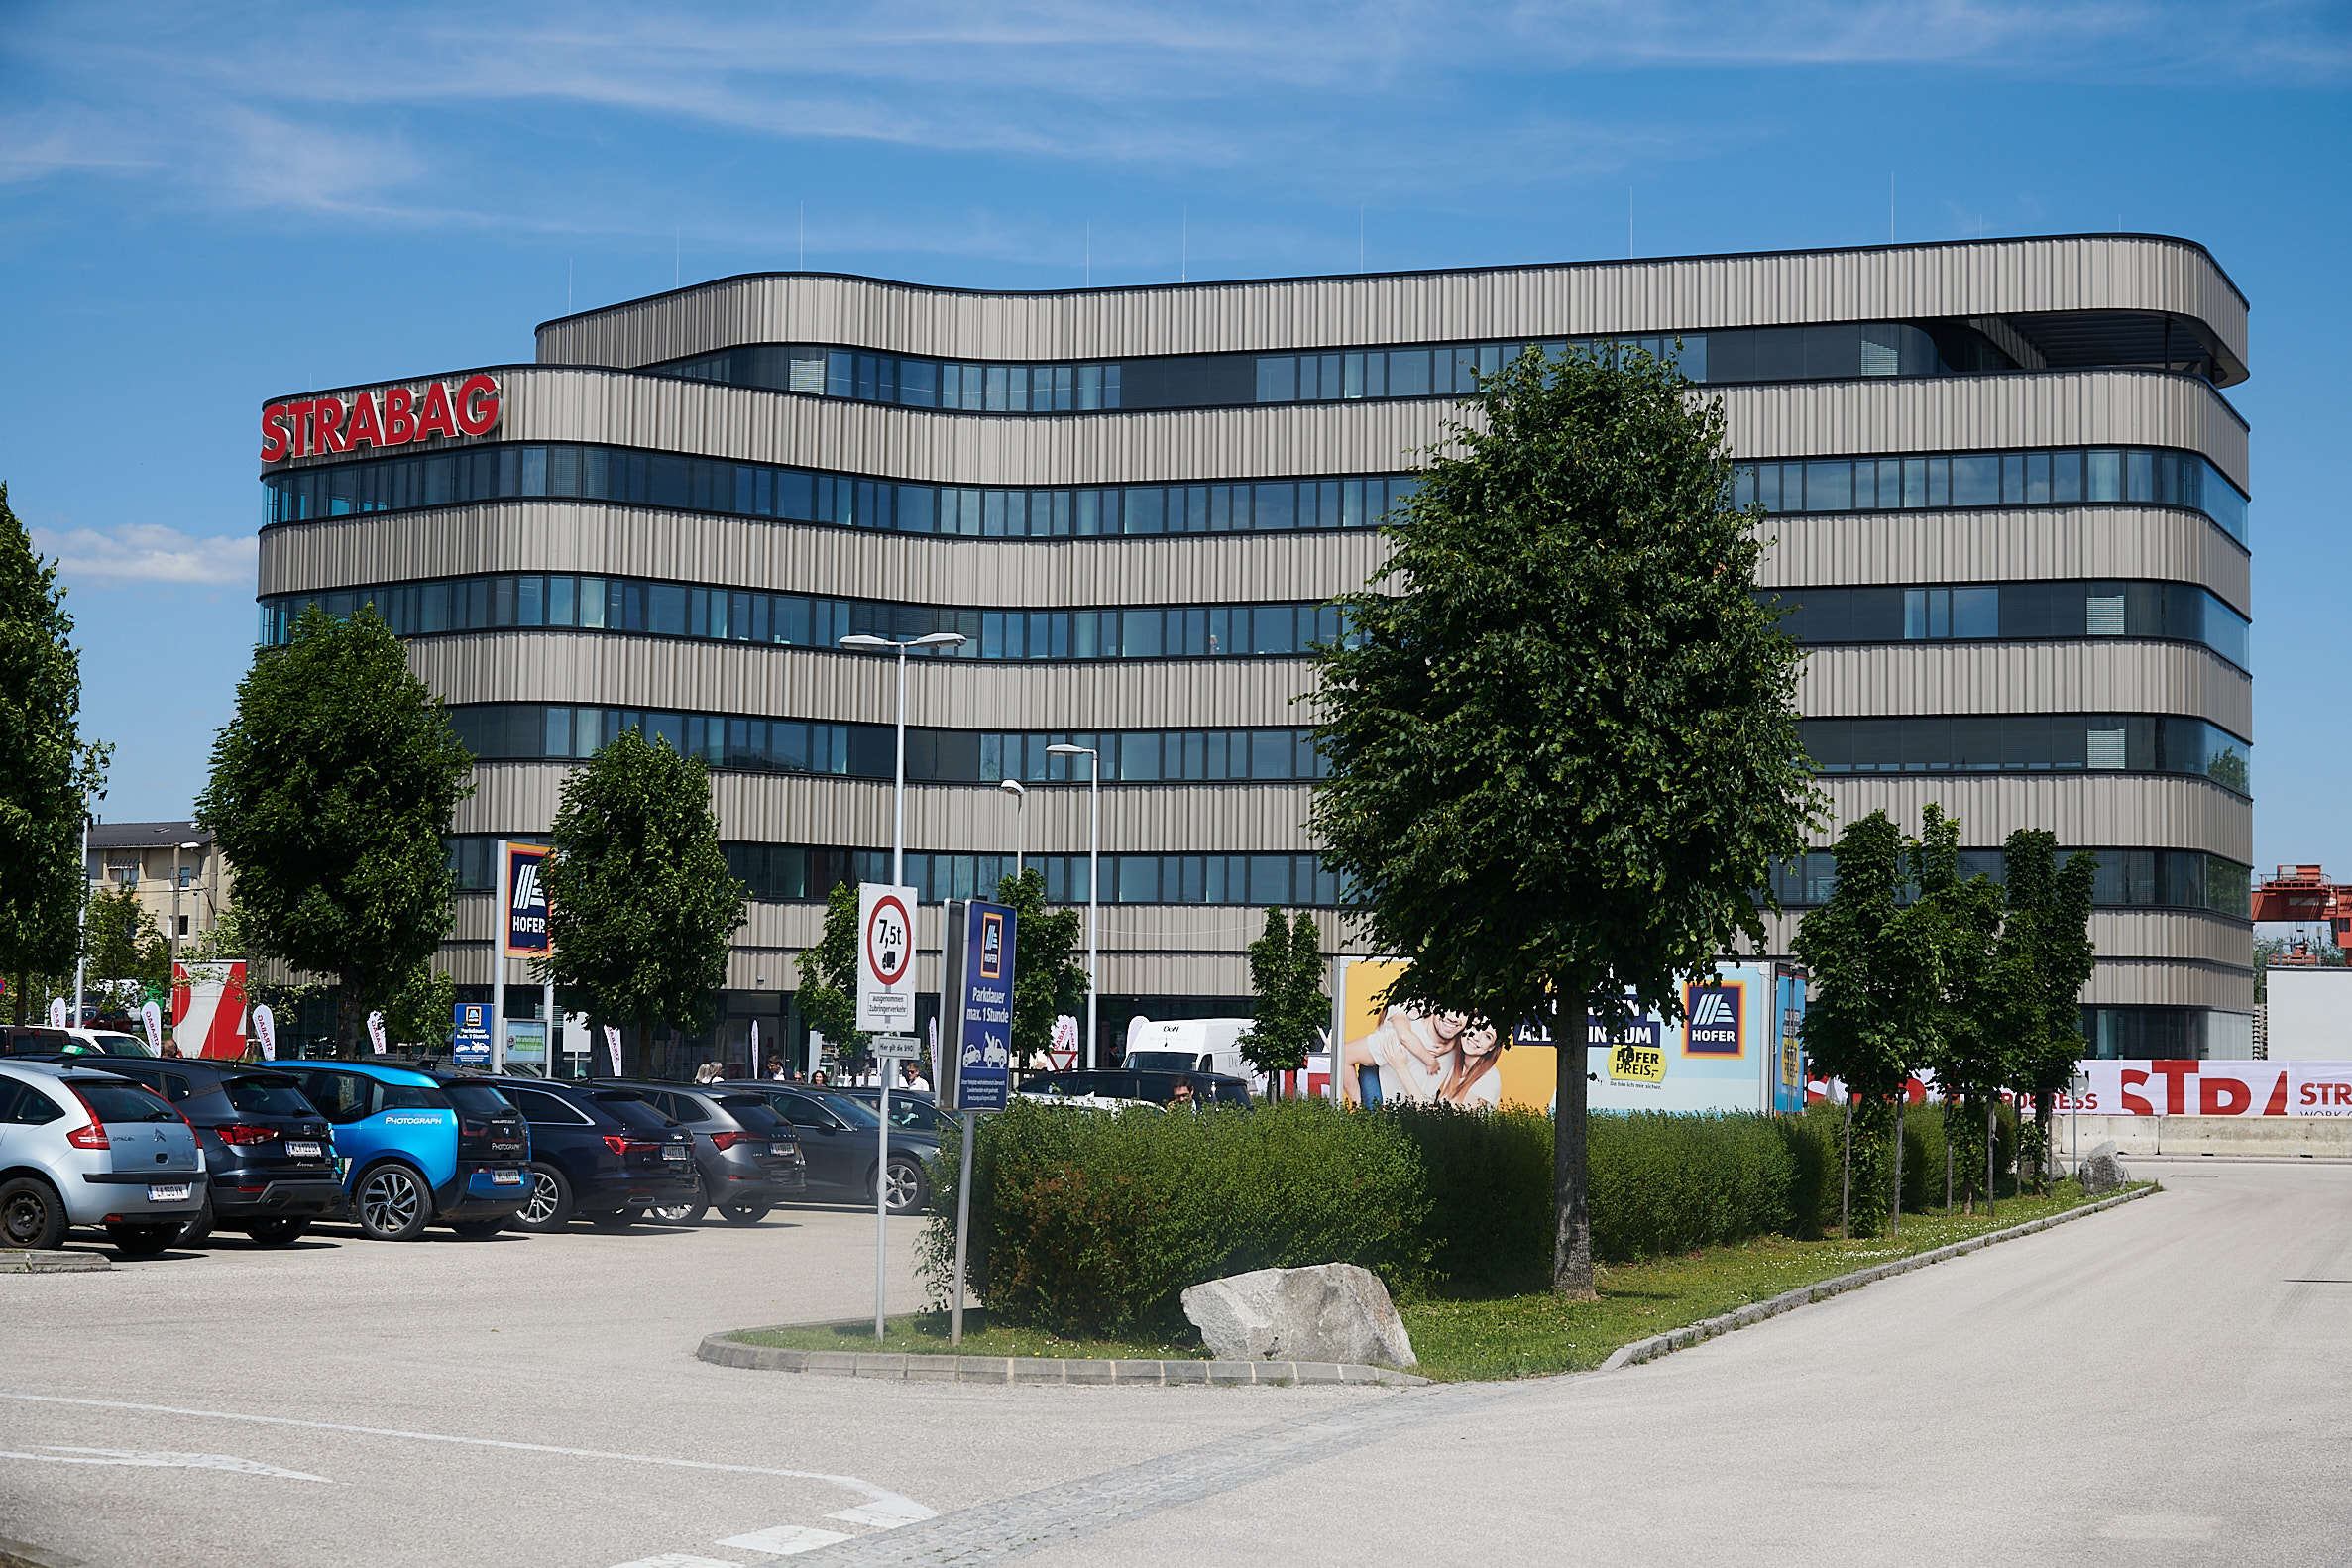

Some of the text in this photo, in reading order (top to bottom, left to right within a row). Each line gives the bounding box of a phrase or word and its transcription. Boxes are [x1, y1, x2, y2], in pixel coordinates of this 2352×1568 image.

[260, 375, 502, 463] STRABAG
[512, 916, 545, 933] HOFER
[878, 919, 901, 949] 7,5t
[984, 953, 998, 964] HOFER
[972, 987, 1005, 1004] Parkdauer
[869, 1004, 906, 1014] Zubringerverkehr
[966, 1007, 1009, 1023] max. 1 Stunde
[1692, 1029, 1736, 1042] HOFER
